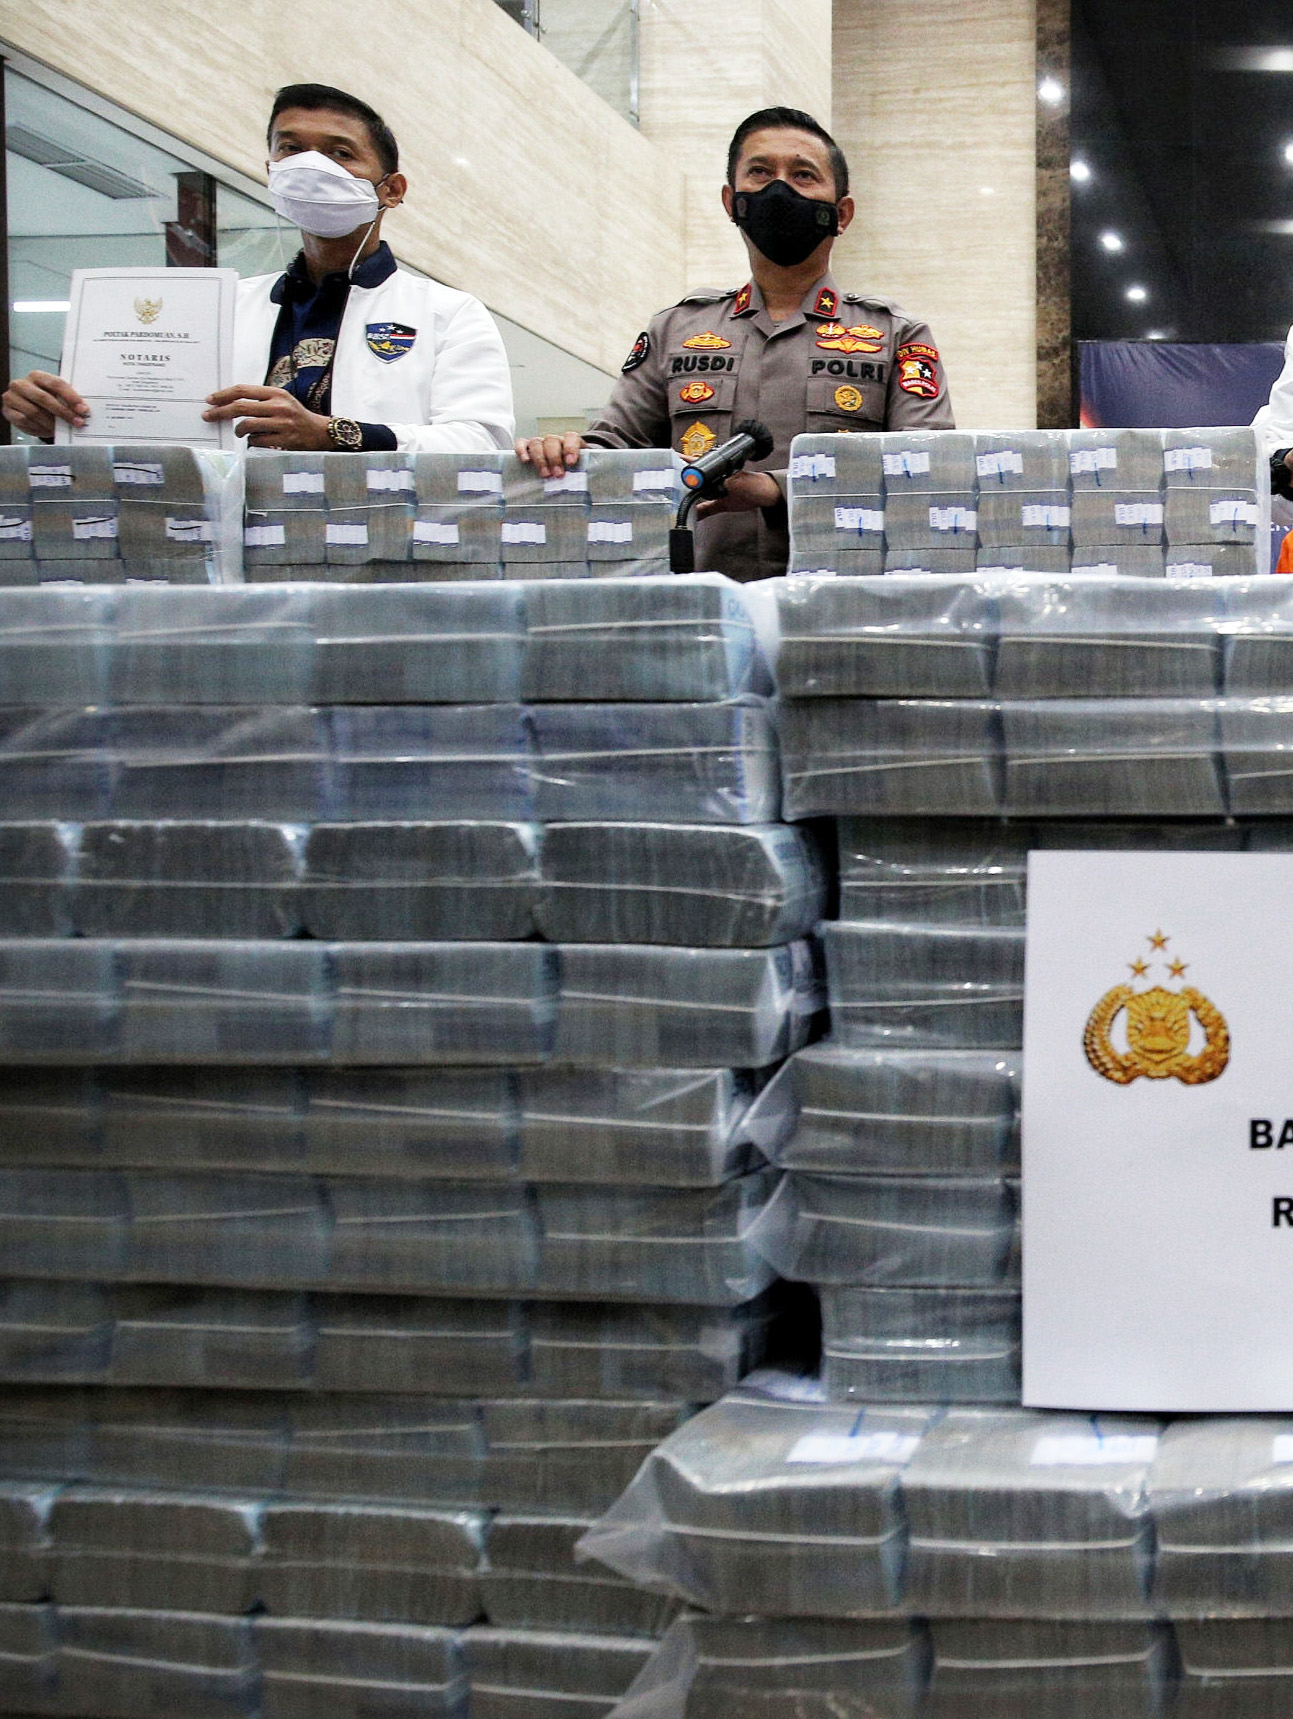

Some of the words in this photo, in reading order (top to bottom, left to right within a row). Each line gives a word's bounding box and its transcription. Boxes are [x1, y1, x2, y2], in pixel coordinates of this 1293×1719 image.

[120, 353, 171, 362] NOTARIS
[671, 355, 733, 373] RUSDI
[811, 359, 884, 382] POLRI
